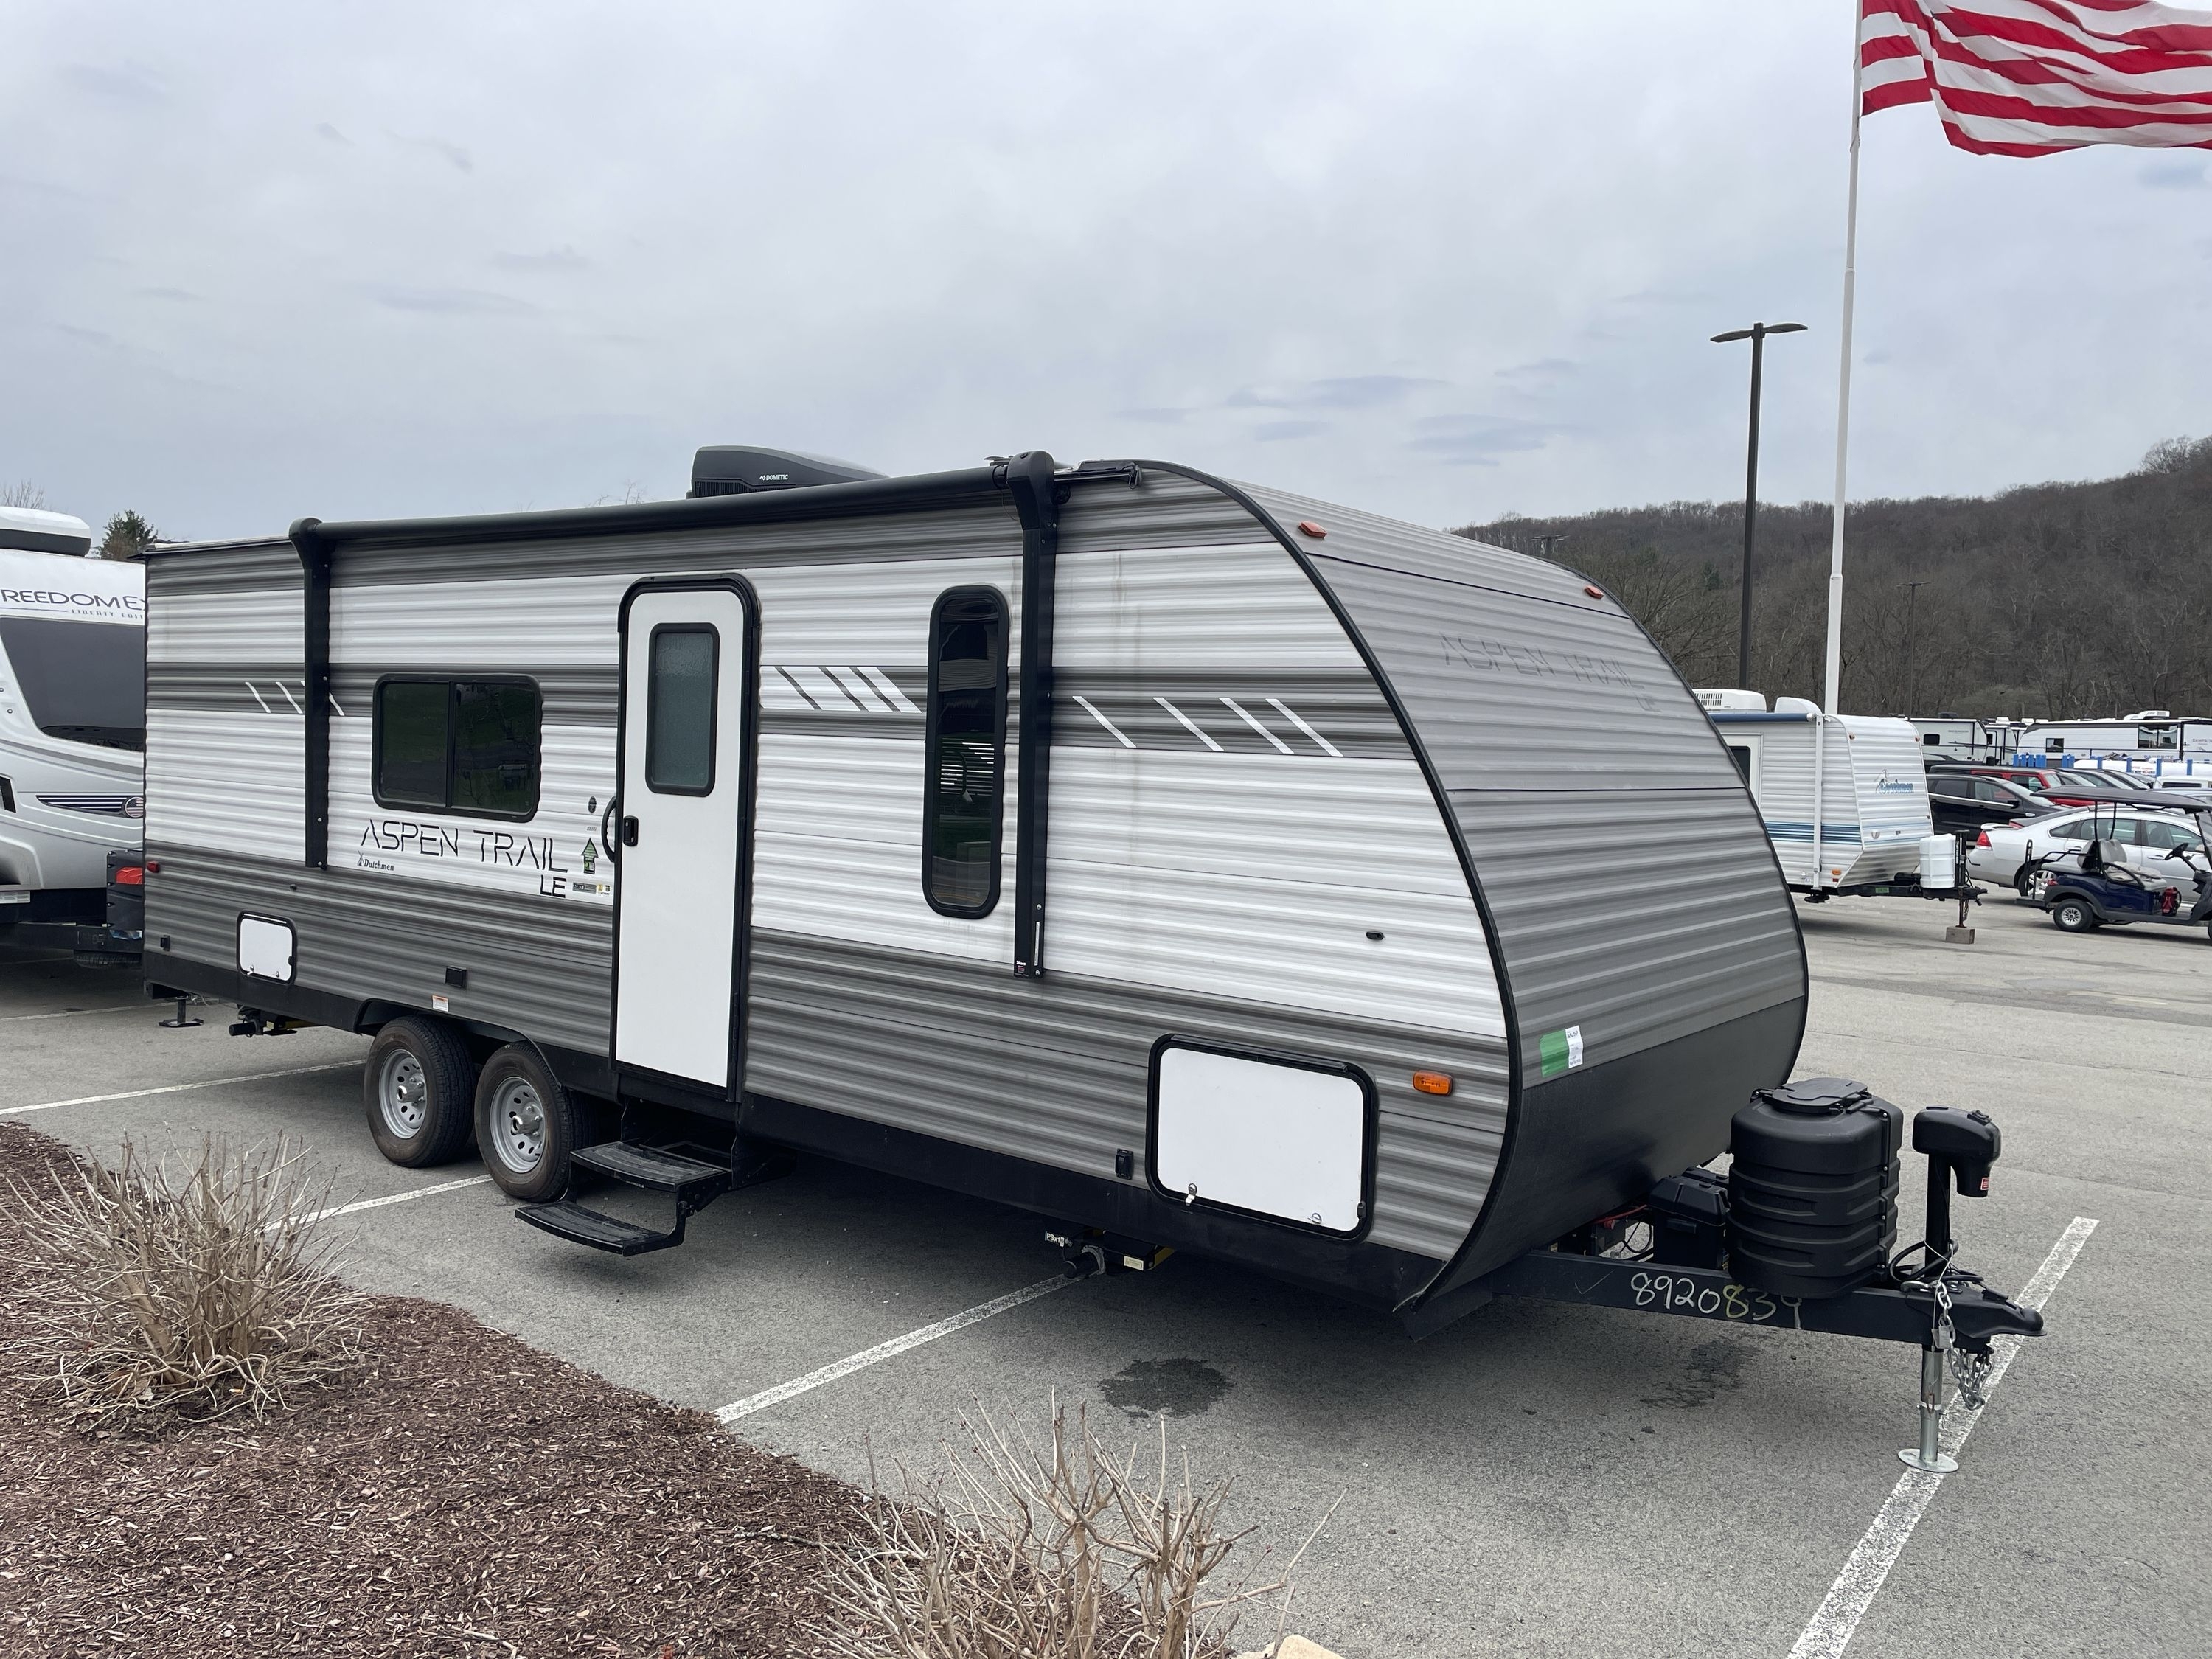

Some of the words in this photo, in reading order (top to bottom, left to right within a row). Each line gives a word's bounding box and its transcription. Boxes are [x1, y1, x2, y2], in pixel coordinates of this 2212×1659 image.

[1438, 632, 1556, 678] ASPEN
[1563, 654, 1645, 689] TRAIL
[360, 818, 459, 858] ASPEN
[473, 830, 568, 873] TRAIL
[364, 858, 394, 871] Dutchmen
[540, 874, 567, 898] LE
